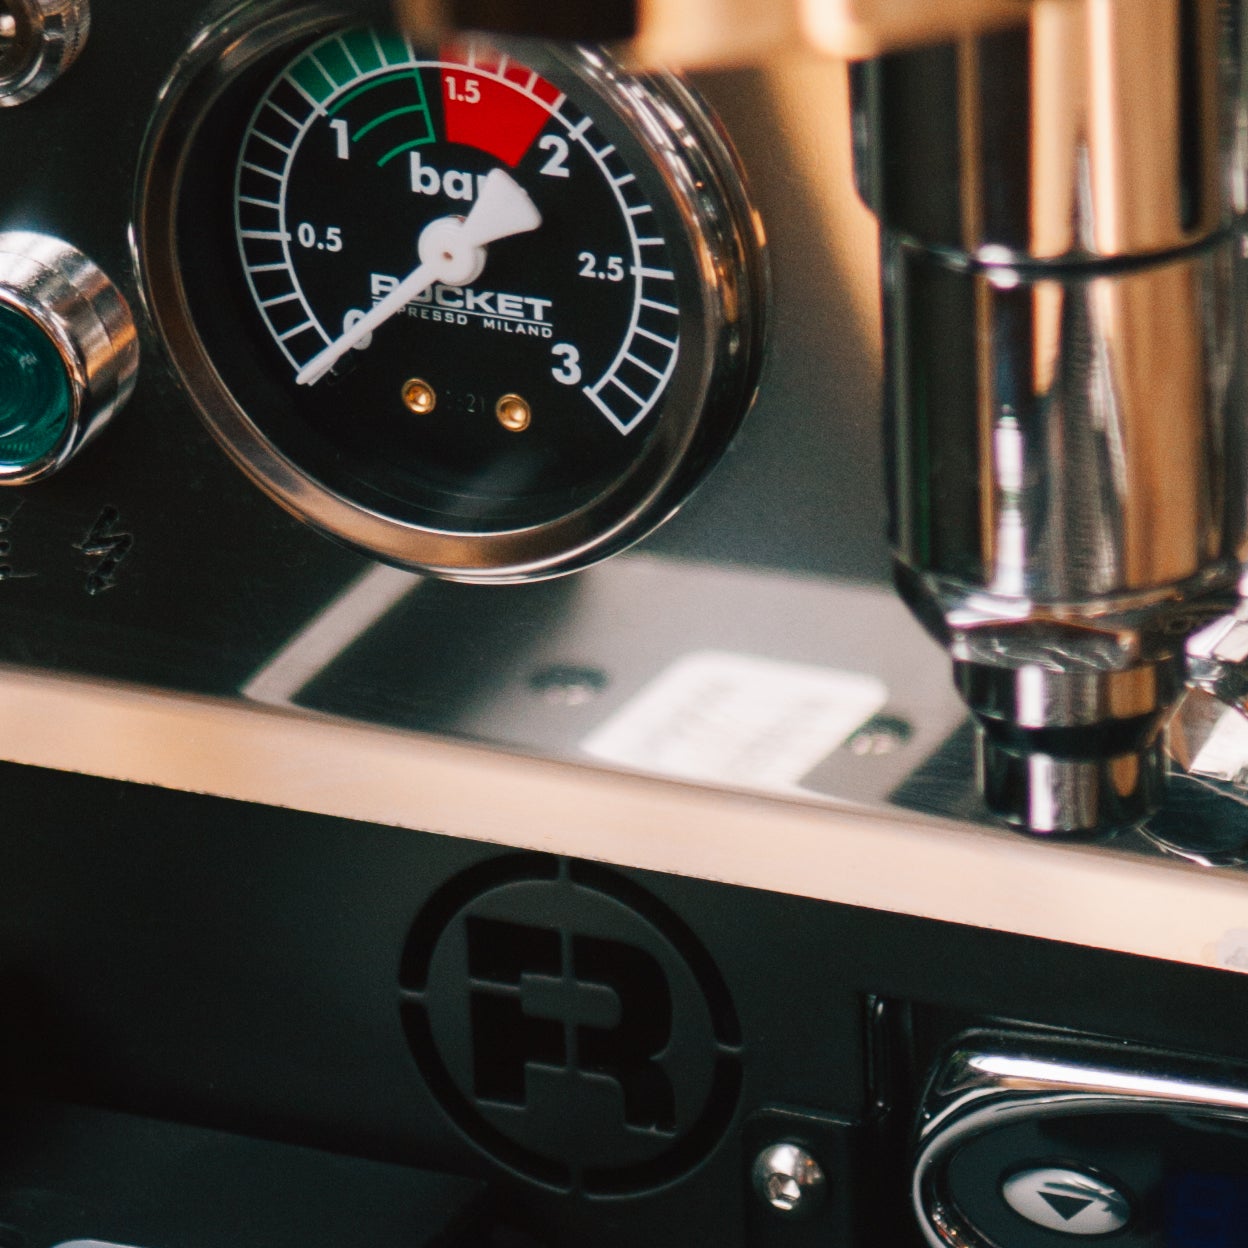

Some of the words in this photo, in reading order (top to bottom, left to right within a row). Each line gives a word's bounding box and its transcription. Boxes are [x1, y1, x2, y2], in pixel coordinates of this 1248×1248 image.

[445, 76, 482, 104] 1.5
[329, 118, 349, 160] 1
[538, 133, 570, 178] 2
[297, 222, 343, 252] 0.5
[578, 251, 625, 282] 2.5
[551, 343, 582, 386] 3
